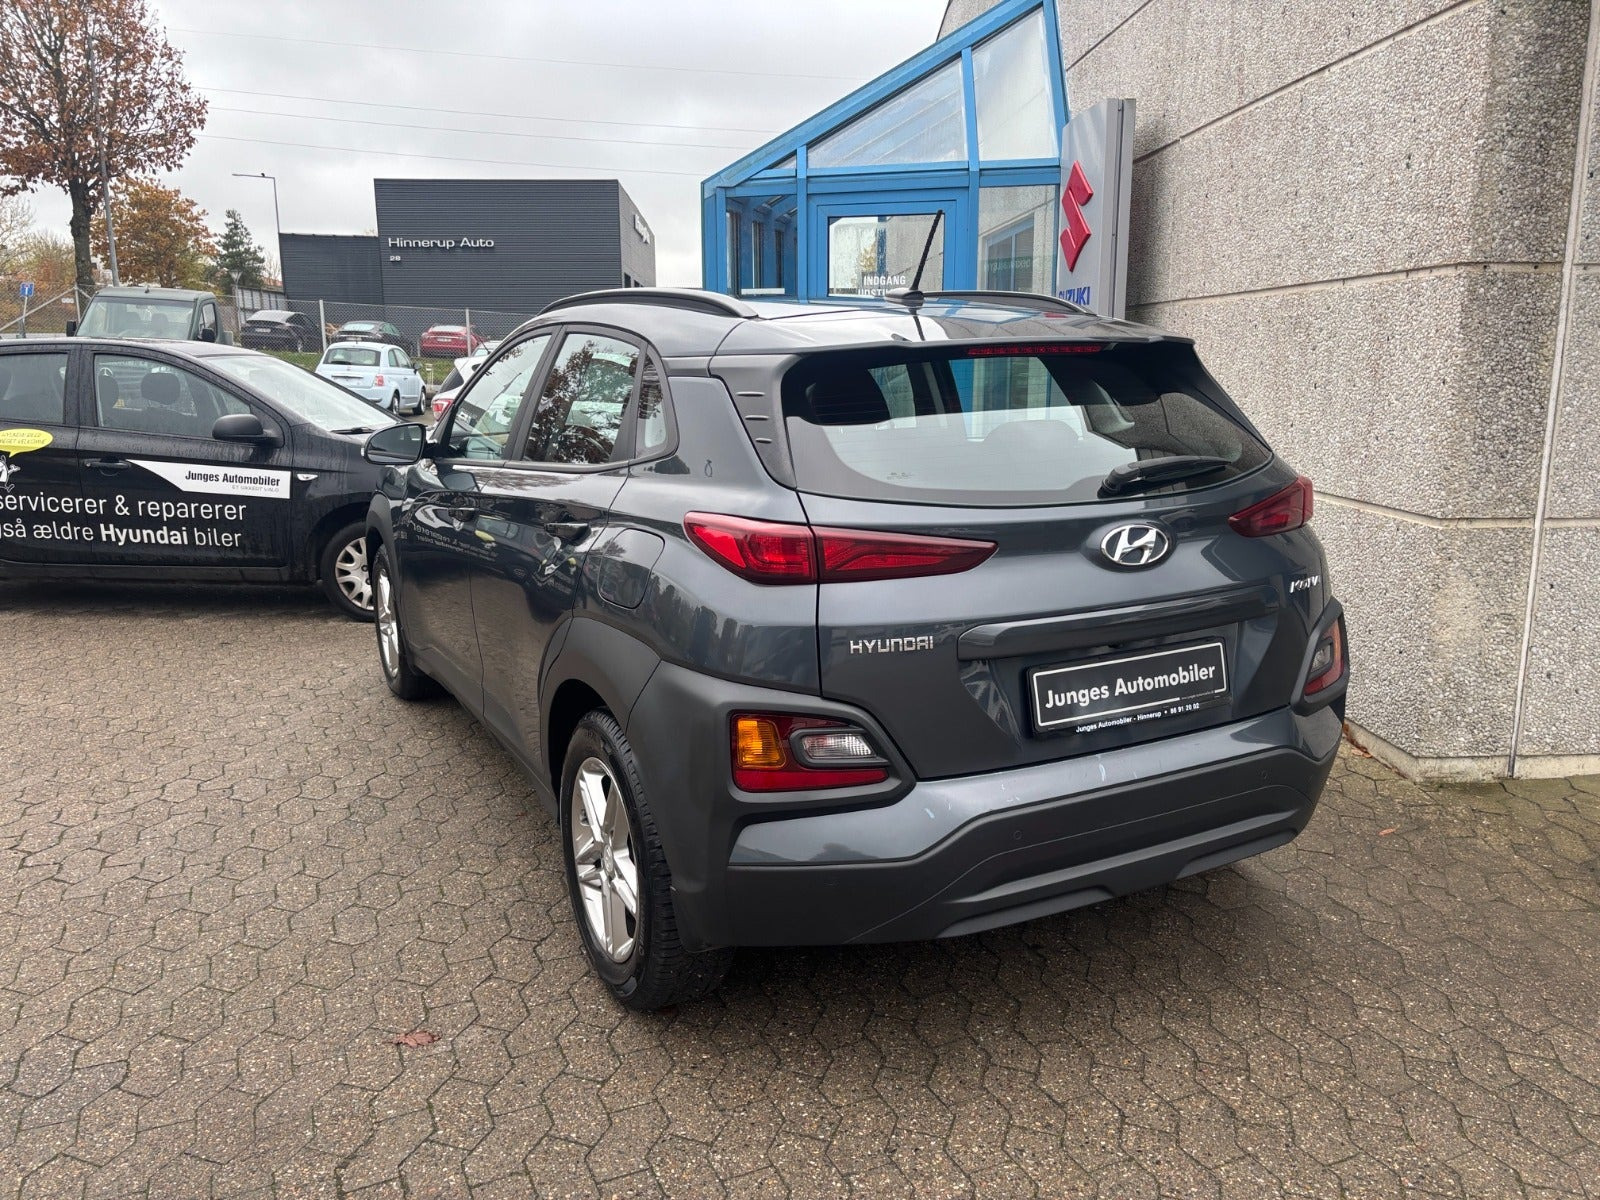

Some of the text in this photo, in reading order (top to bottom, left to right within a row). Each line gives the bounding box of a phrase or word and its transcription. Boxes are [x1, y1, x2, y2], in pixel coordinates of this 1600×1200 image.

[388, 237, 494, 250] Hinnerup Auto
[863, 275, 906, 286] INDGANG
[185, 470, 280, 486] Junges Automobiler
[115, 494, 130, 516] &
[138, 500, 247, 521] reparerer
[0, 518, 242, 547] så ældre Hyundai biler
[849, 635, 934, 654] HYUNDAI
[1045, 664, 1216, 709] Junges Automobiler
[1075, 723, 1098, 733] Junges
[1098, 716, 1132, 729] Automobiler
[1137, 711, 1161, 721] Hinnerup
